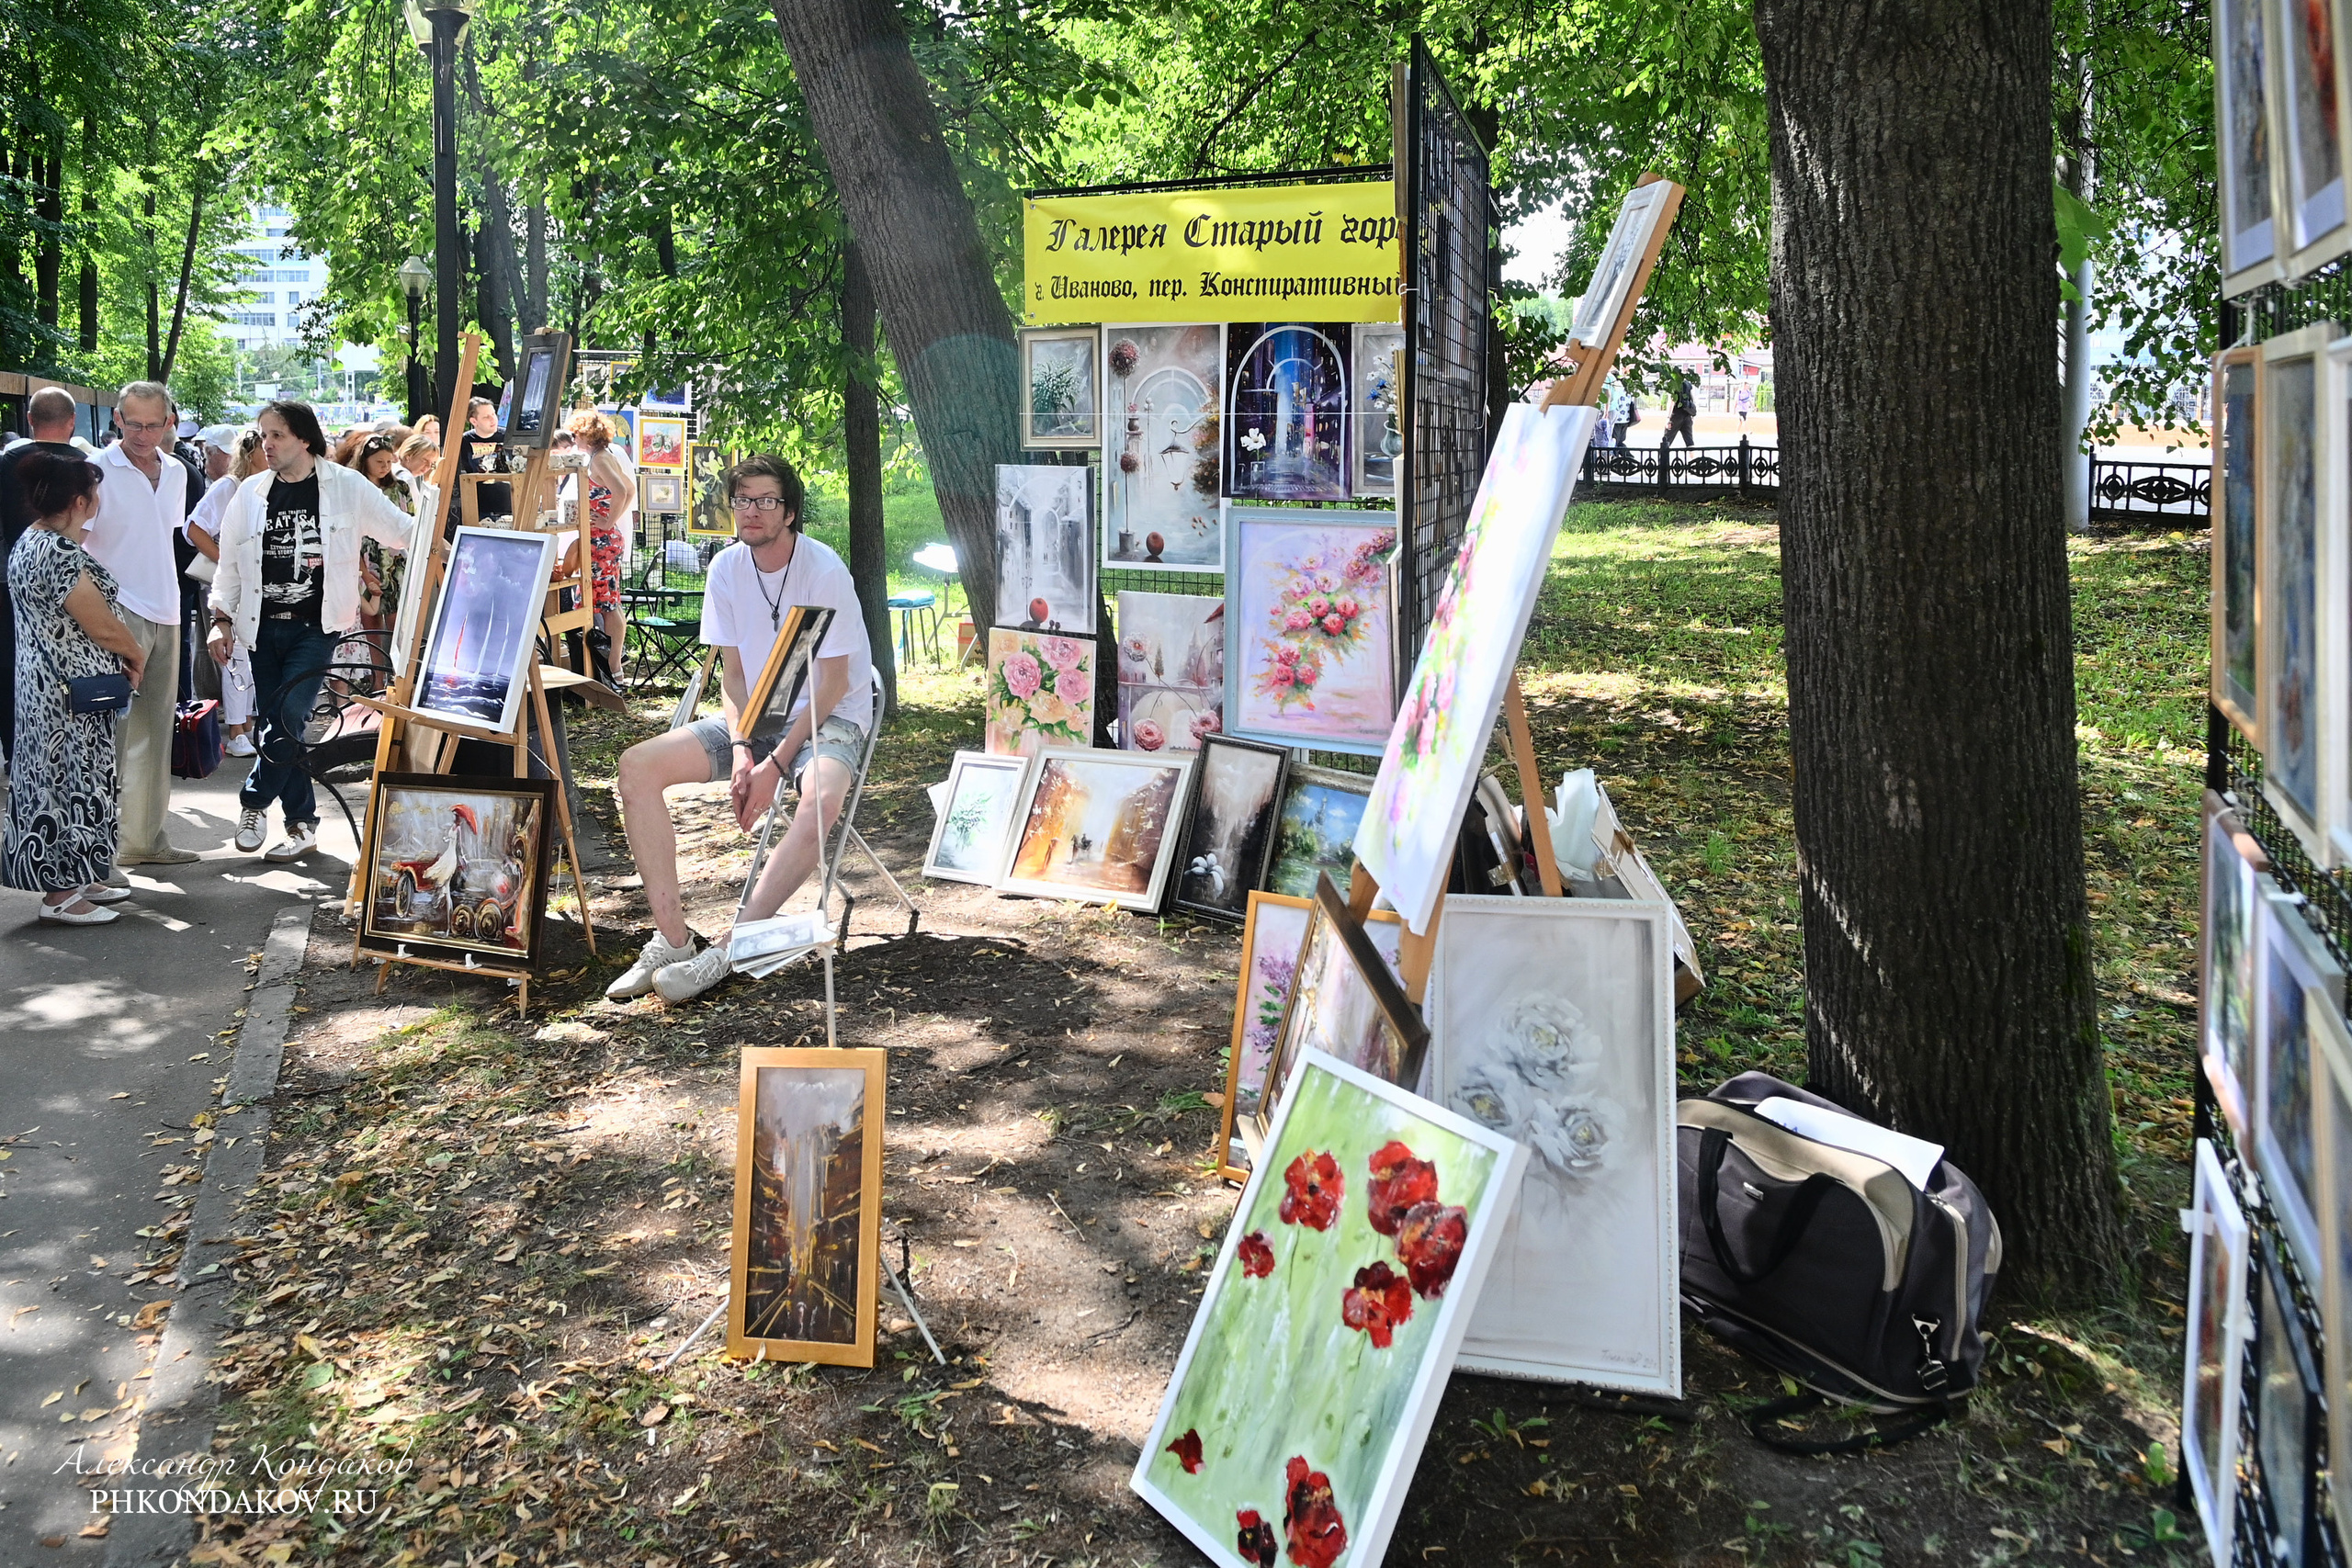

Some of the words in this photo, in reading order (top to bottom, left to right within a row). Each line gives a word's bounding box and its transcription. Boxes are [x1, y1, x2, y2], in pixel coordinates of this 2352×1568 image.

[1045, 217, 1168, 256] Галерея
[1183, 210, 1323, 253] Старый
[1340, 215, 1399, 250] гор
[1050, 275, 1137, 299] Иваново,
[1148, 279, 1188, 301] пер.
[266, 514, 291, 532] EAT
